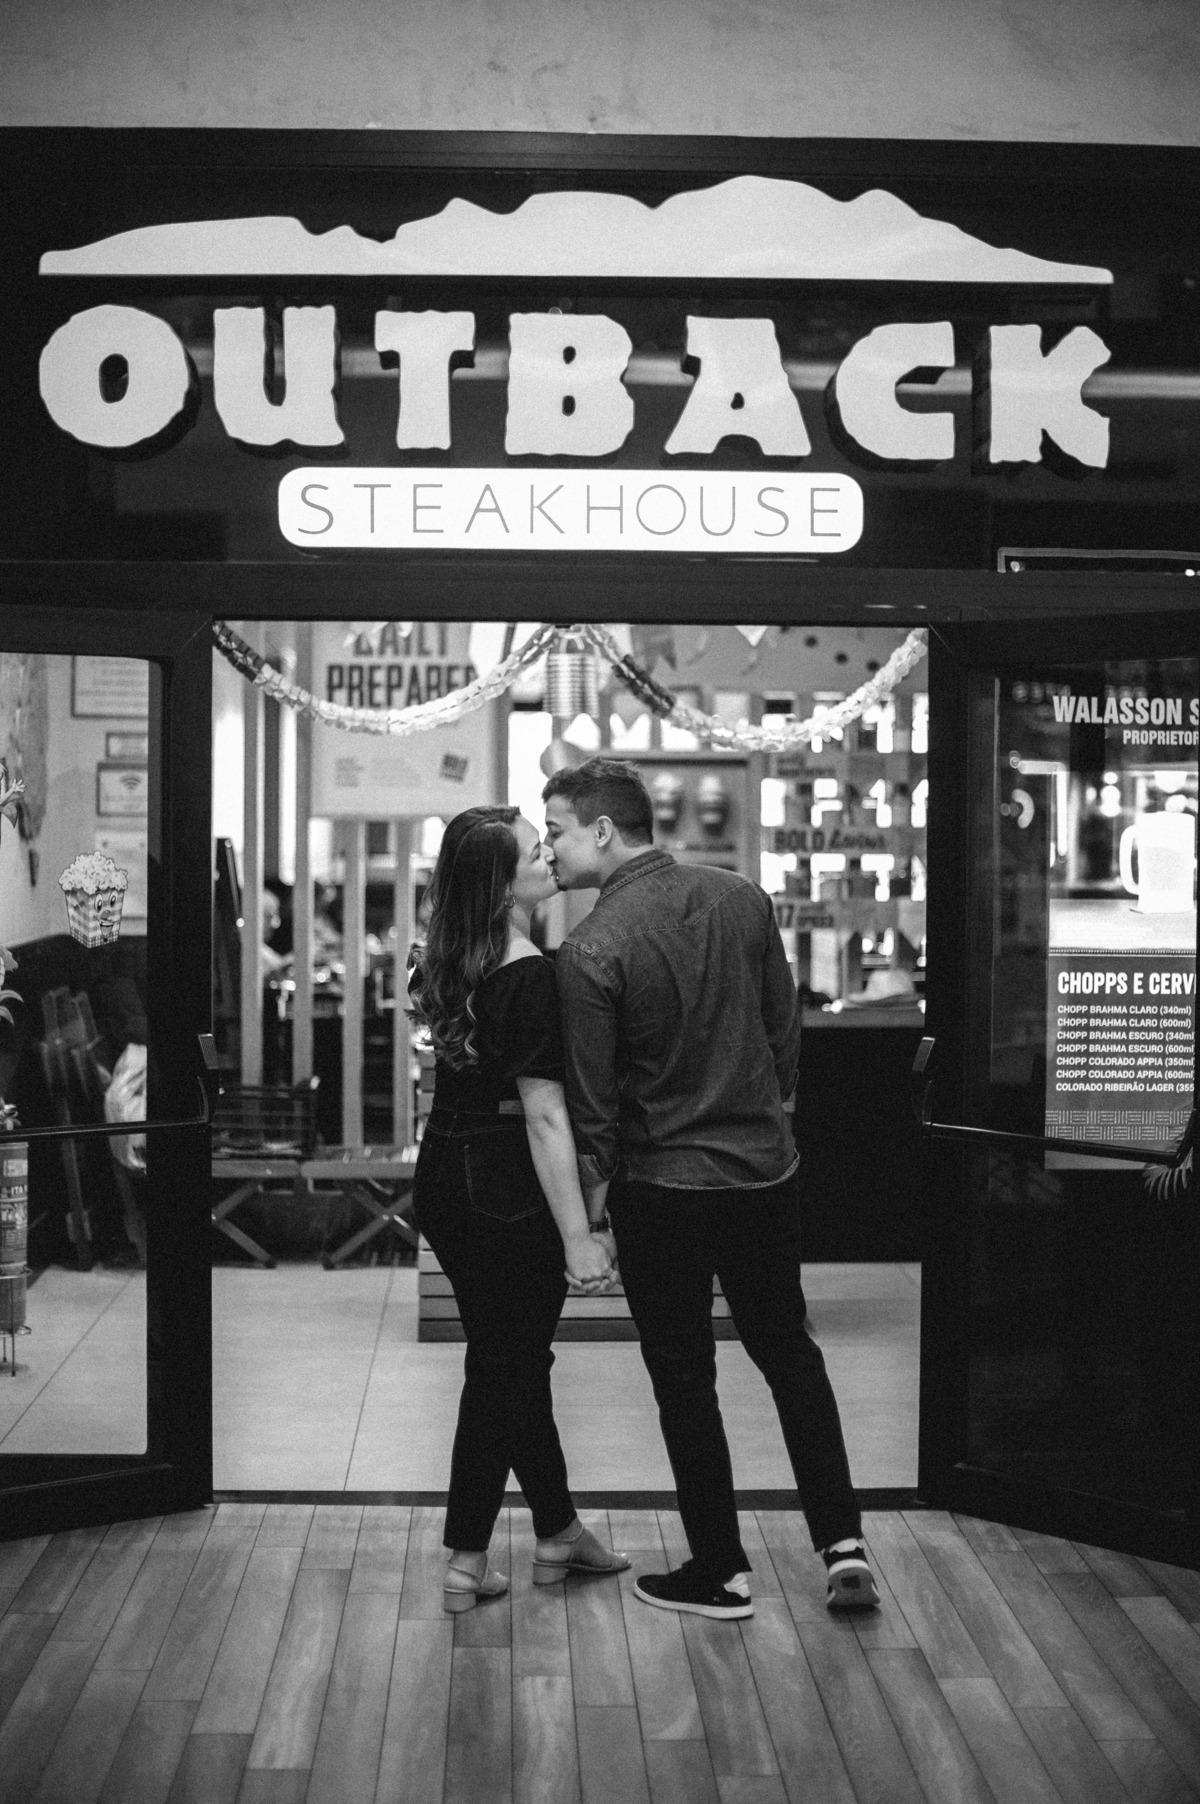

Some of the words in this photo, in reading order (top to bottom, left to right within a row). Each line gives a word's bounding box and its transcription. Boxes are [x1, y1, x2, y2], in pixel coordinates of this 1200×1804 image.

[39, 303, 1112, 469] OUTBACK
[296, 482, 846, 538] STEAKHOUSE
[1052, 695, 1183, 726] WALASSON
[1057, 971, 1128, 994] CHOPPS
[1133, 972, 1144, 994] E
[1057, 1005, 1088, 1014] CHOPP
[1089, 1005, 1128, 1014] BRAHMA
[1129, 1005, 1158, 1014] CLARO
[1159, 1005, 1191, 1015] (340ml)
[1057, 1018, 1088, 1027] CHOPP
[1089, 1018, 1127, 1027] BRAHMA
[1129, 1018, 1158, 1027] CLARO
[1159, 1019, 1191, 1028] (600ml)
[1057, 1031, 1088, 1040] CHOPP
[1089, 1031, 1127, 1040] BRAHMA
[1128, 1031, 1164, 1040] ESCURO
[1056, 1044, 1087, 1053] CHOPP
[1089, 1044, 1127, 1053] BRAHMA
[1128, 1044, 1163, 1053] ESCURO
[1056, 1057, 1087, 1066] CHOPP
[1088, 1057, 1135, 1066] COLORADO
[1137, 1058, 1163, 1066] APPIA
[1056, 1070, 1087, 1079] CHOPP
[1088, 1070, 1135, 1079] COLORADO
[1136, 1070, 1163, 1079] APPIA
[1056, 1083, 1103, 1092] COLORADO
[1104, 1082, 1145, 1092] RIBEIRÃO
[1146, 1083, 1174, 1092] LAGER
